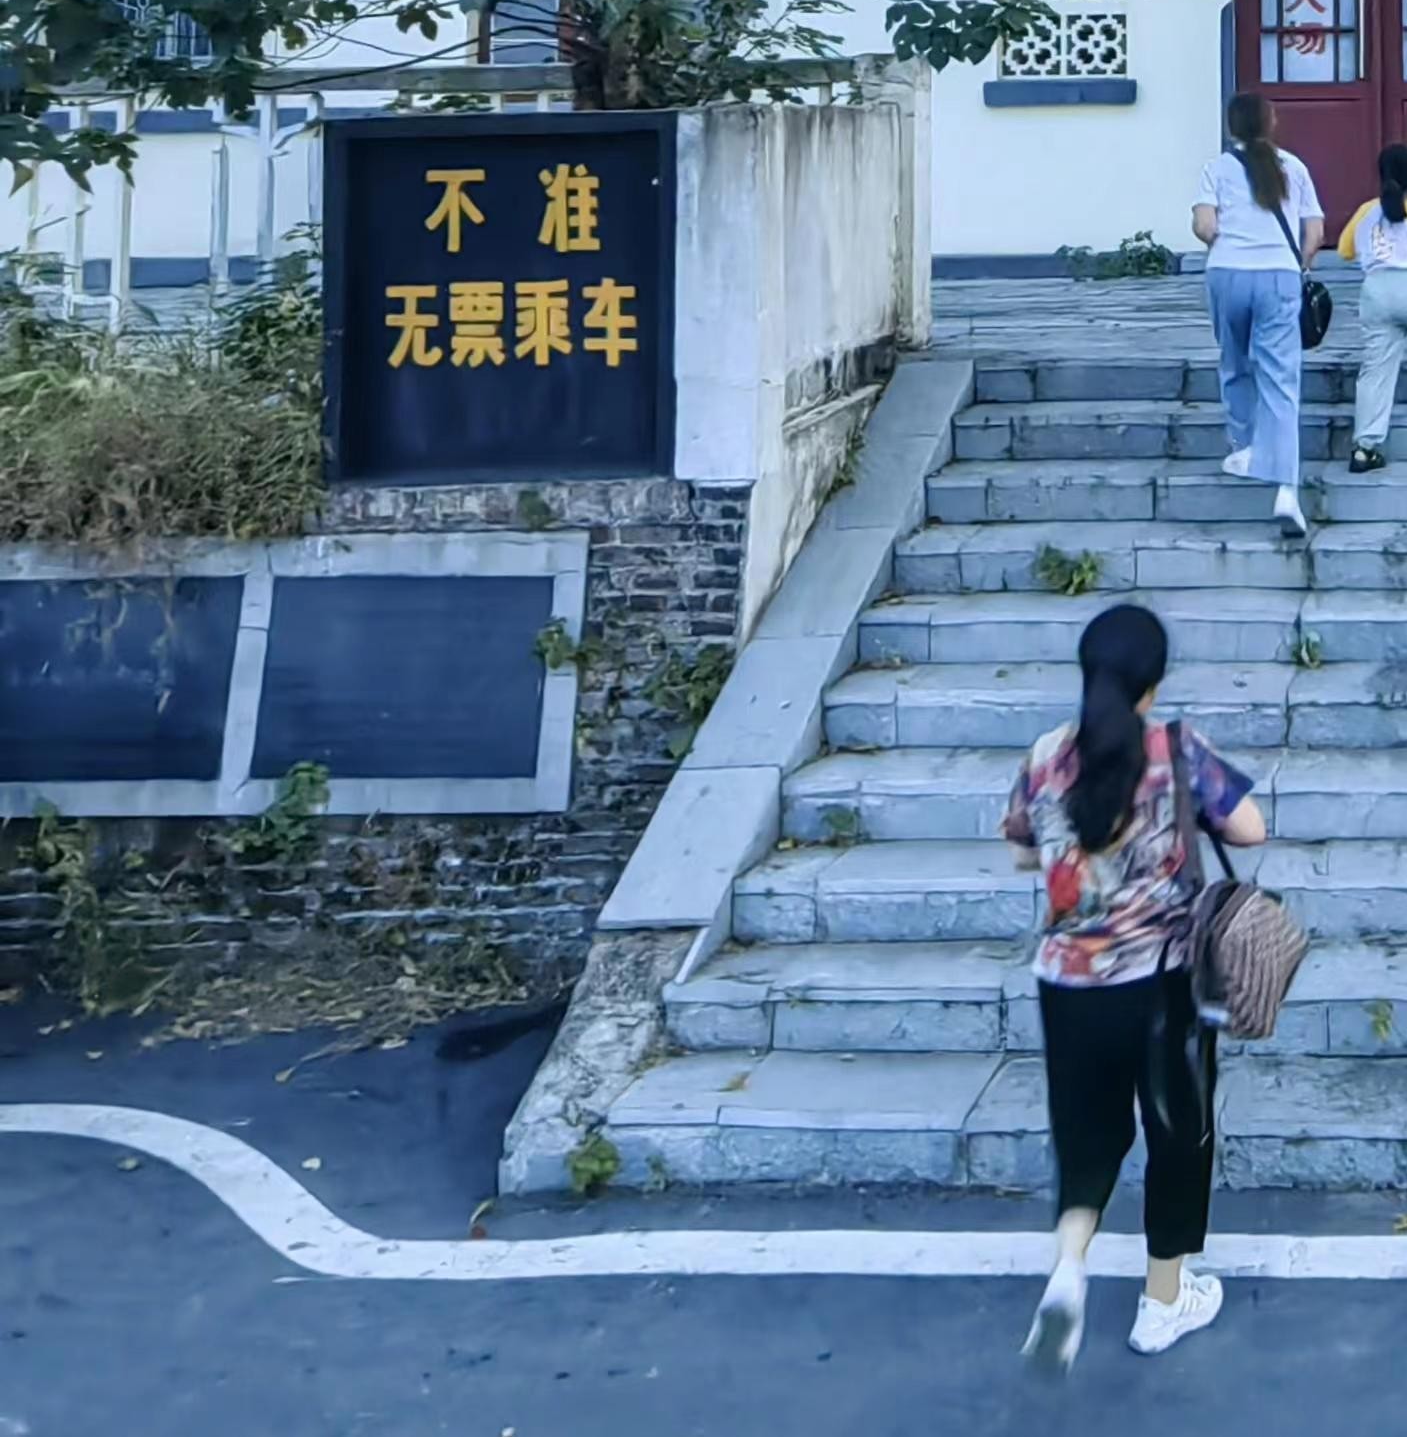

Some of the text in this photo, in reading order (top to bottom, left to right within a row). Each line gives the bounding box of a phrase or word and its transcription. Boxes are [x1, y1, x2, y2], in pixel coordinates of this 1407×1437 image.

[425, 164, 601, 253] 不准
[385, 278, 639, 368] 无票乘车
